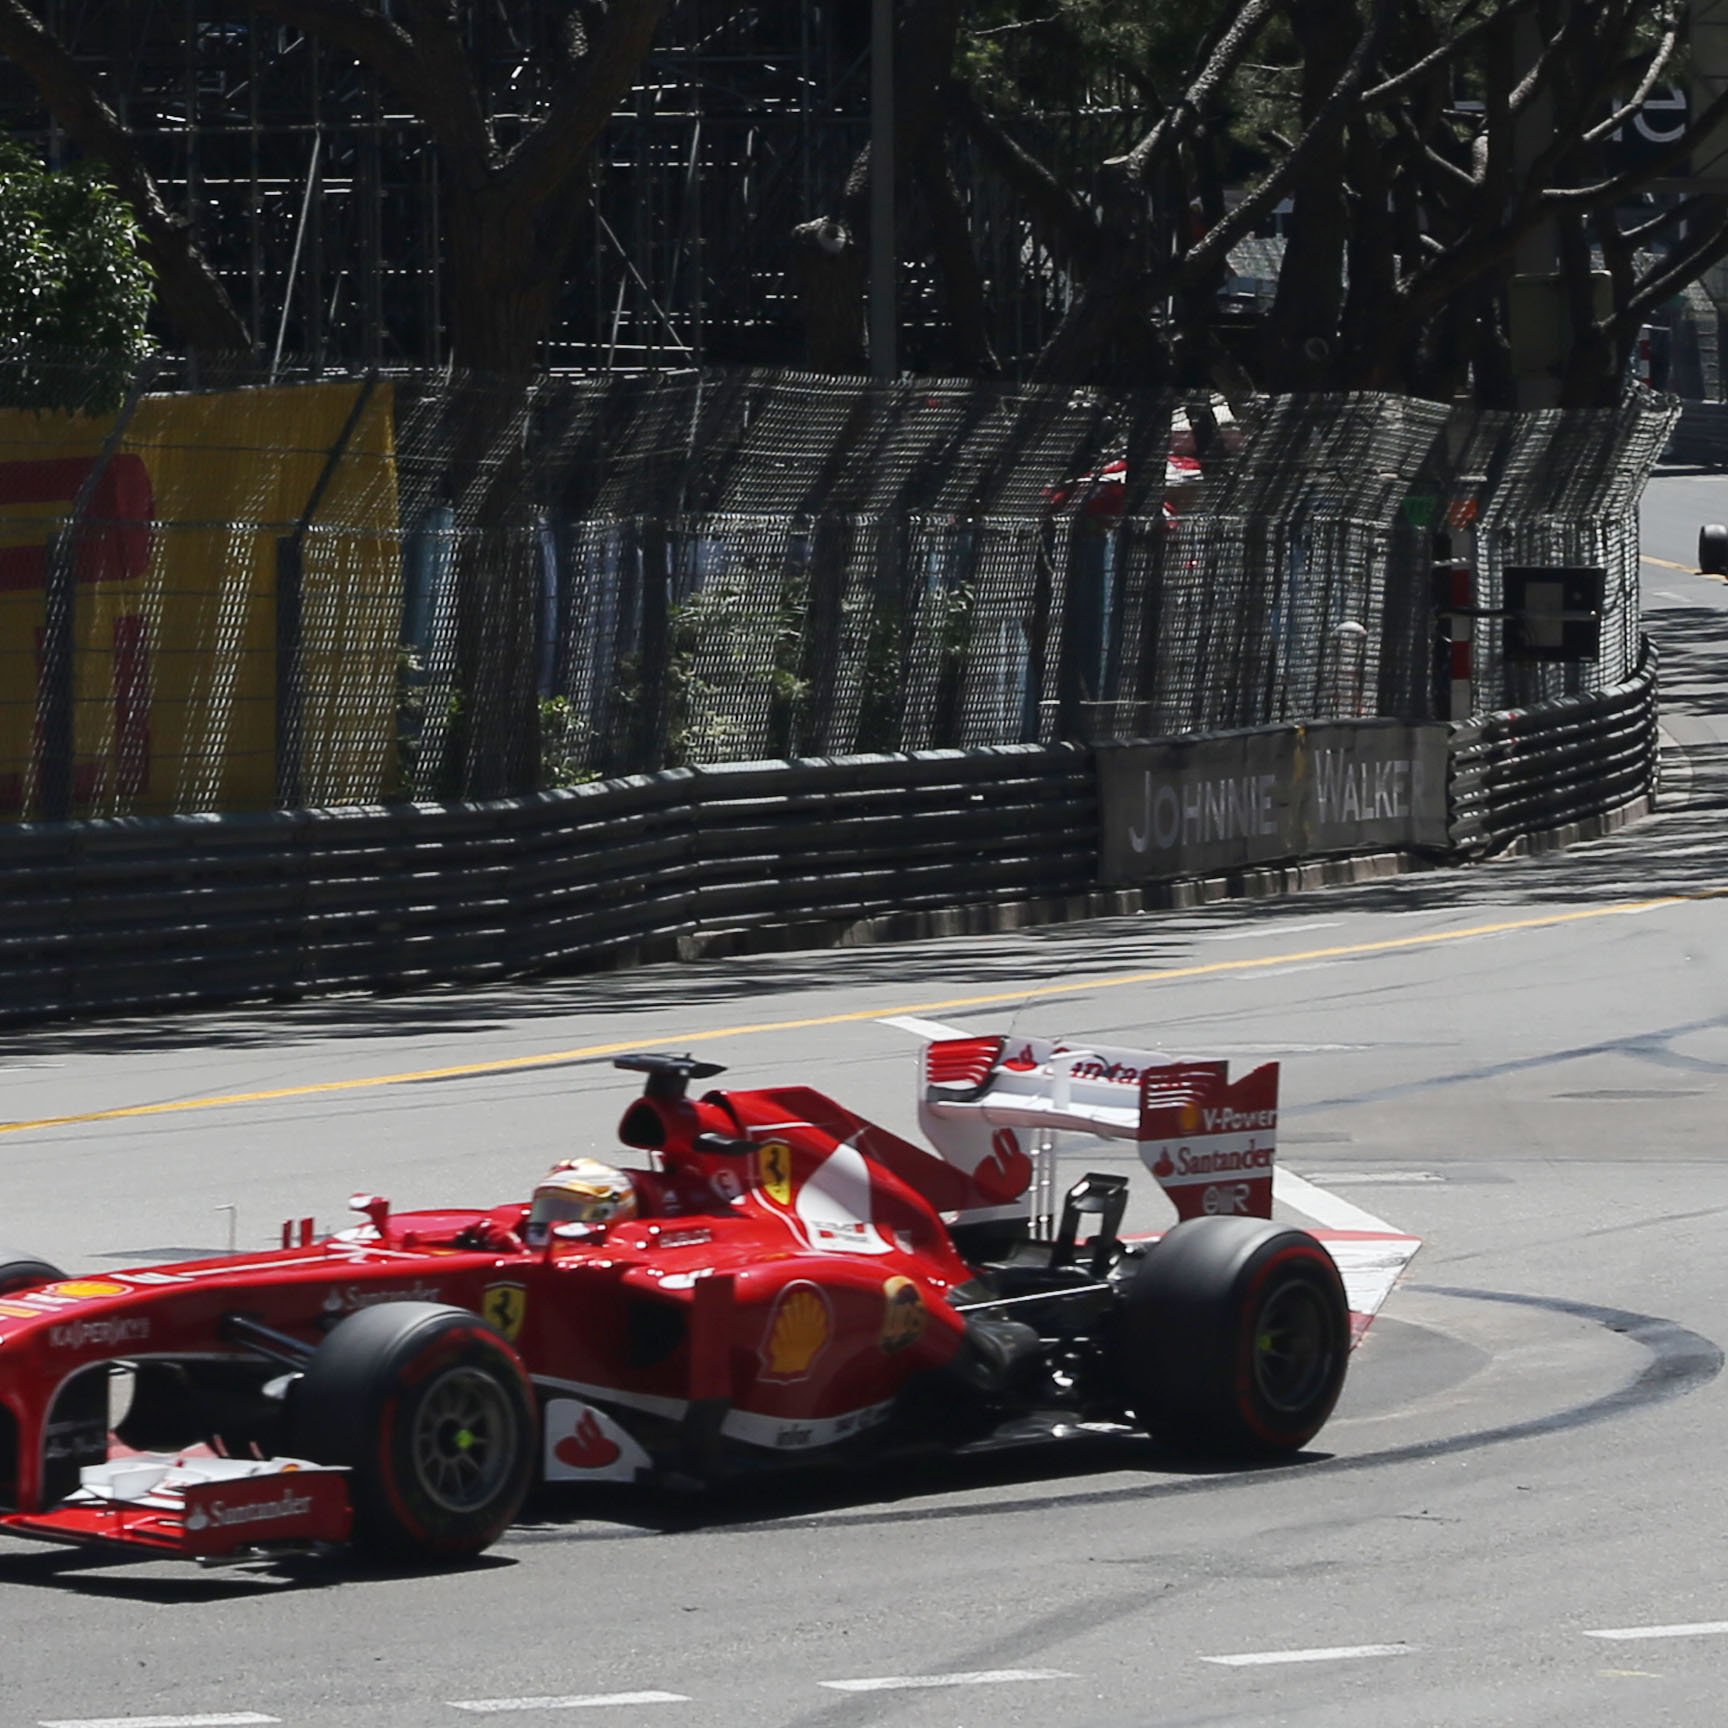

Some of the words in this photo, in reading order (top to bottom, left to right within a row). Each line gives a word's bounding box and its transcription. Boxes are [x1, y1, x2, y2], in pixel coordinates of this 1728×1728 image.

[1128, 771, 1279, 853] JOHNNIE
[1177, 1139, 1276, 1176] Santander
[210, 1488, 313, 1526] Santander
